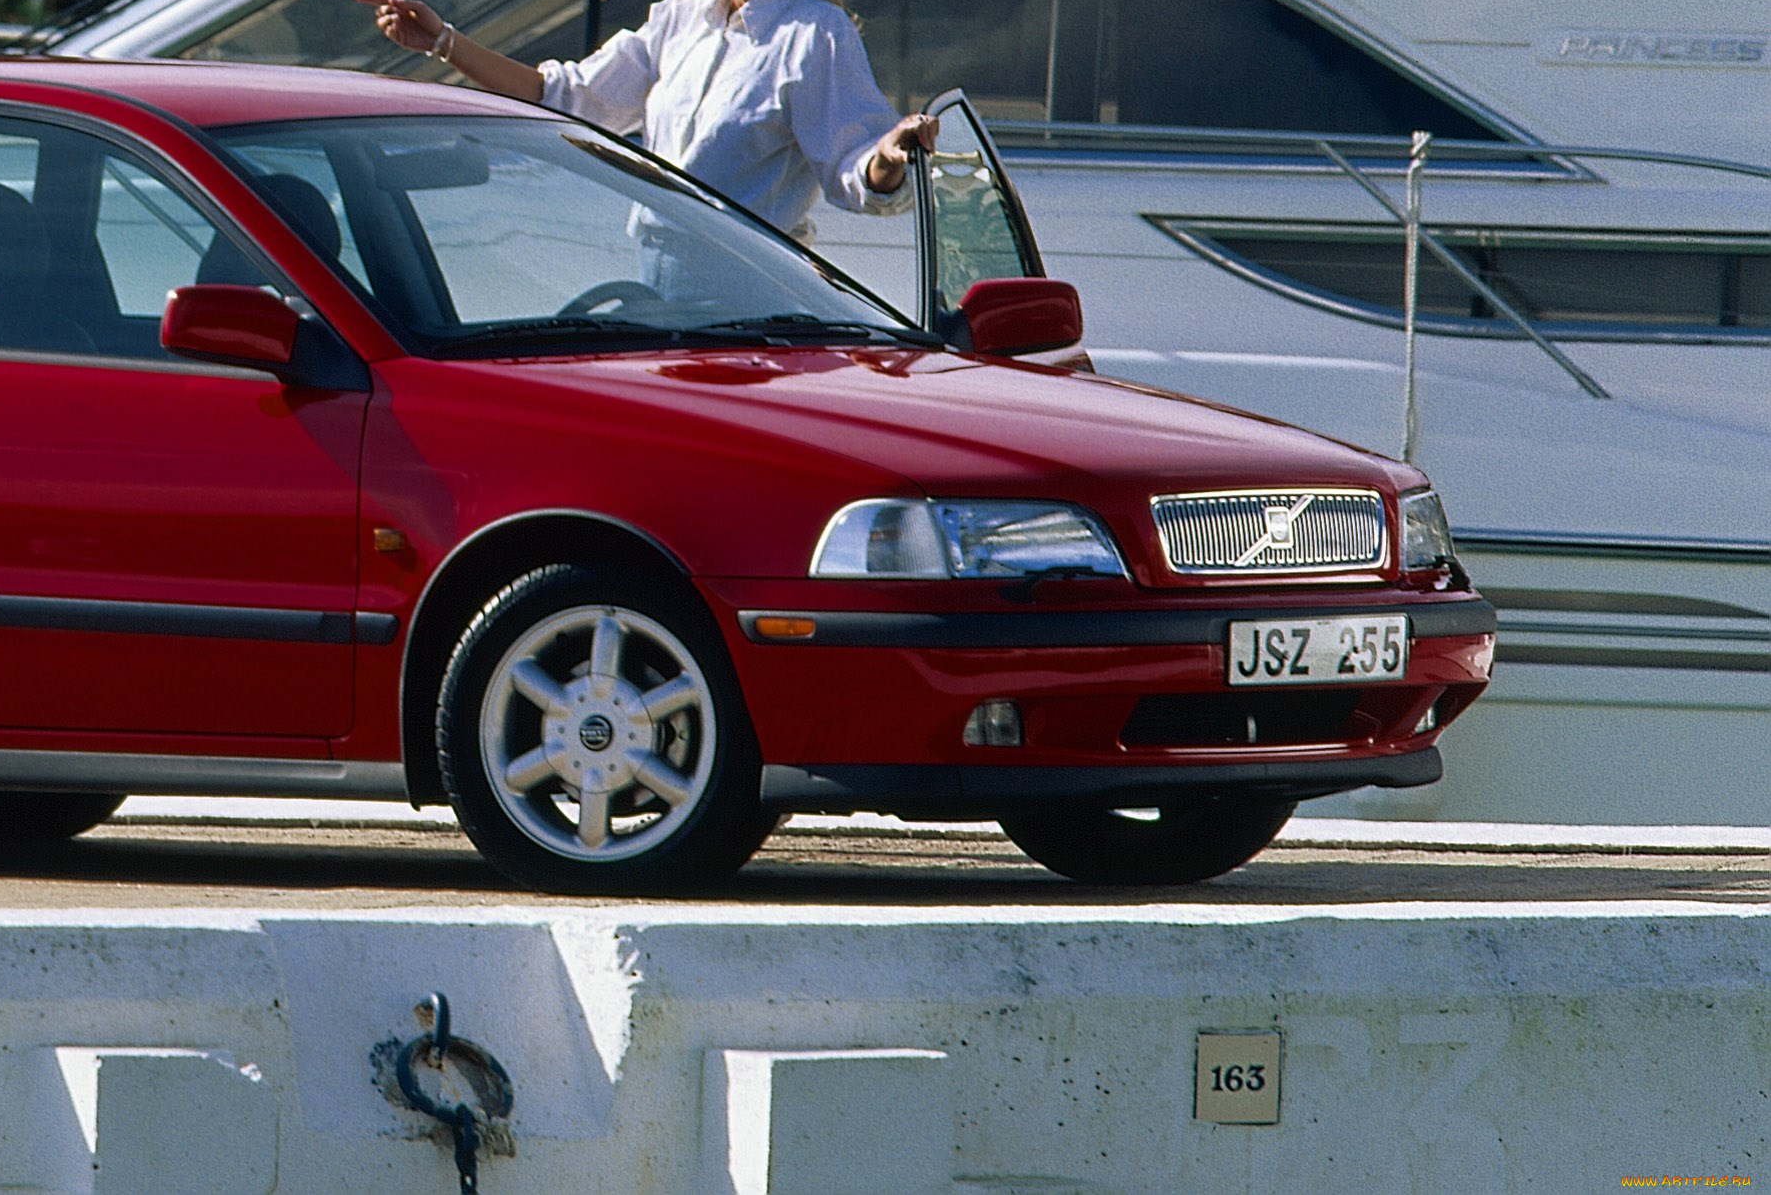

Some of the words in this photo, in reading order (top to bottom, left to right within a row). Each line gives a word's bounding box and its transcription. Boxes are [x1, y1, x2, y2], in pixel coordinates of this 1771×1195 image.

[1559, 36, 1767, 61] PRINCESS
[1237, 628, 1311, 677] JSZ
[1337, 626, 1400, 673] 255
[1211, 1065, 1266, 1092] 163
